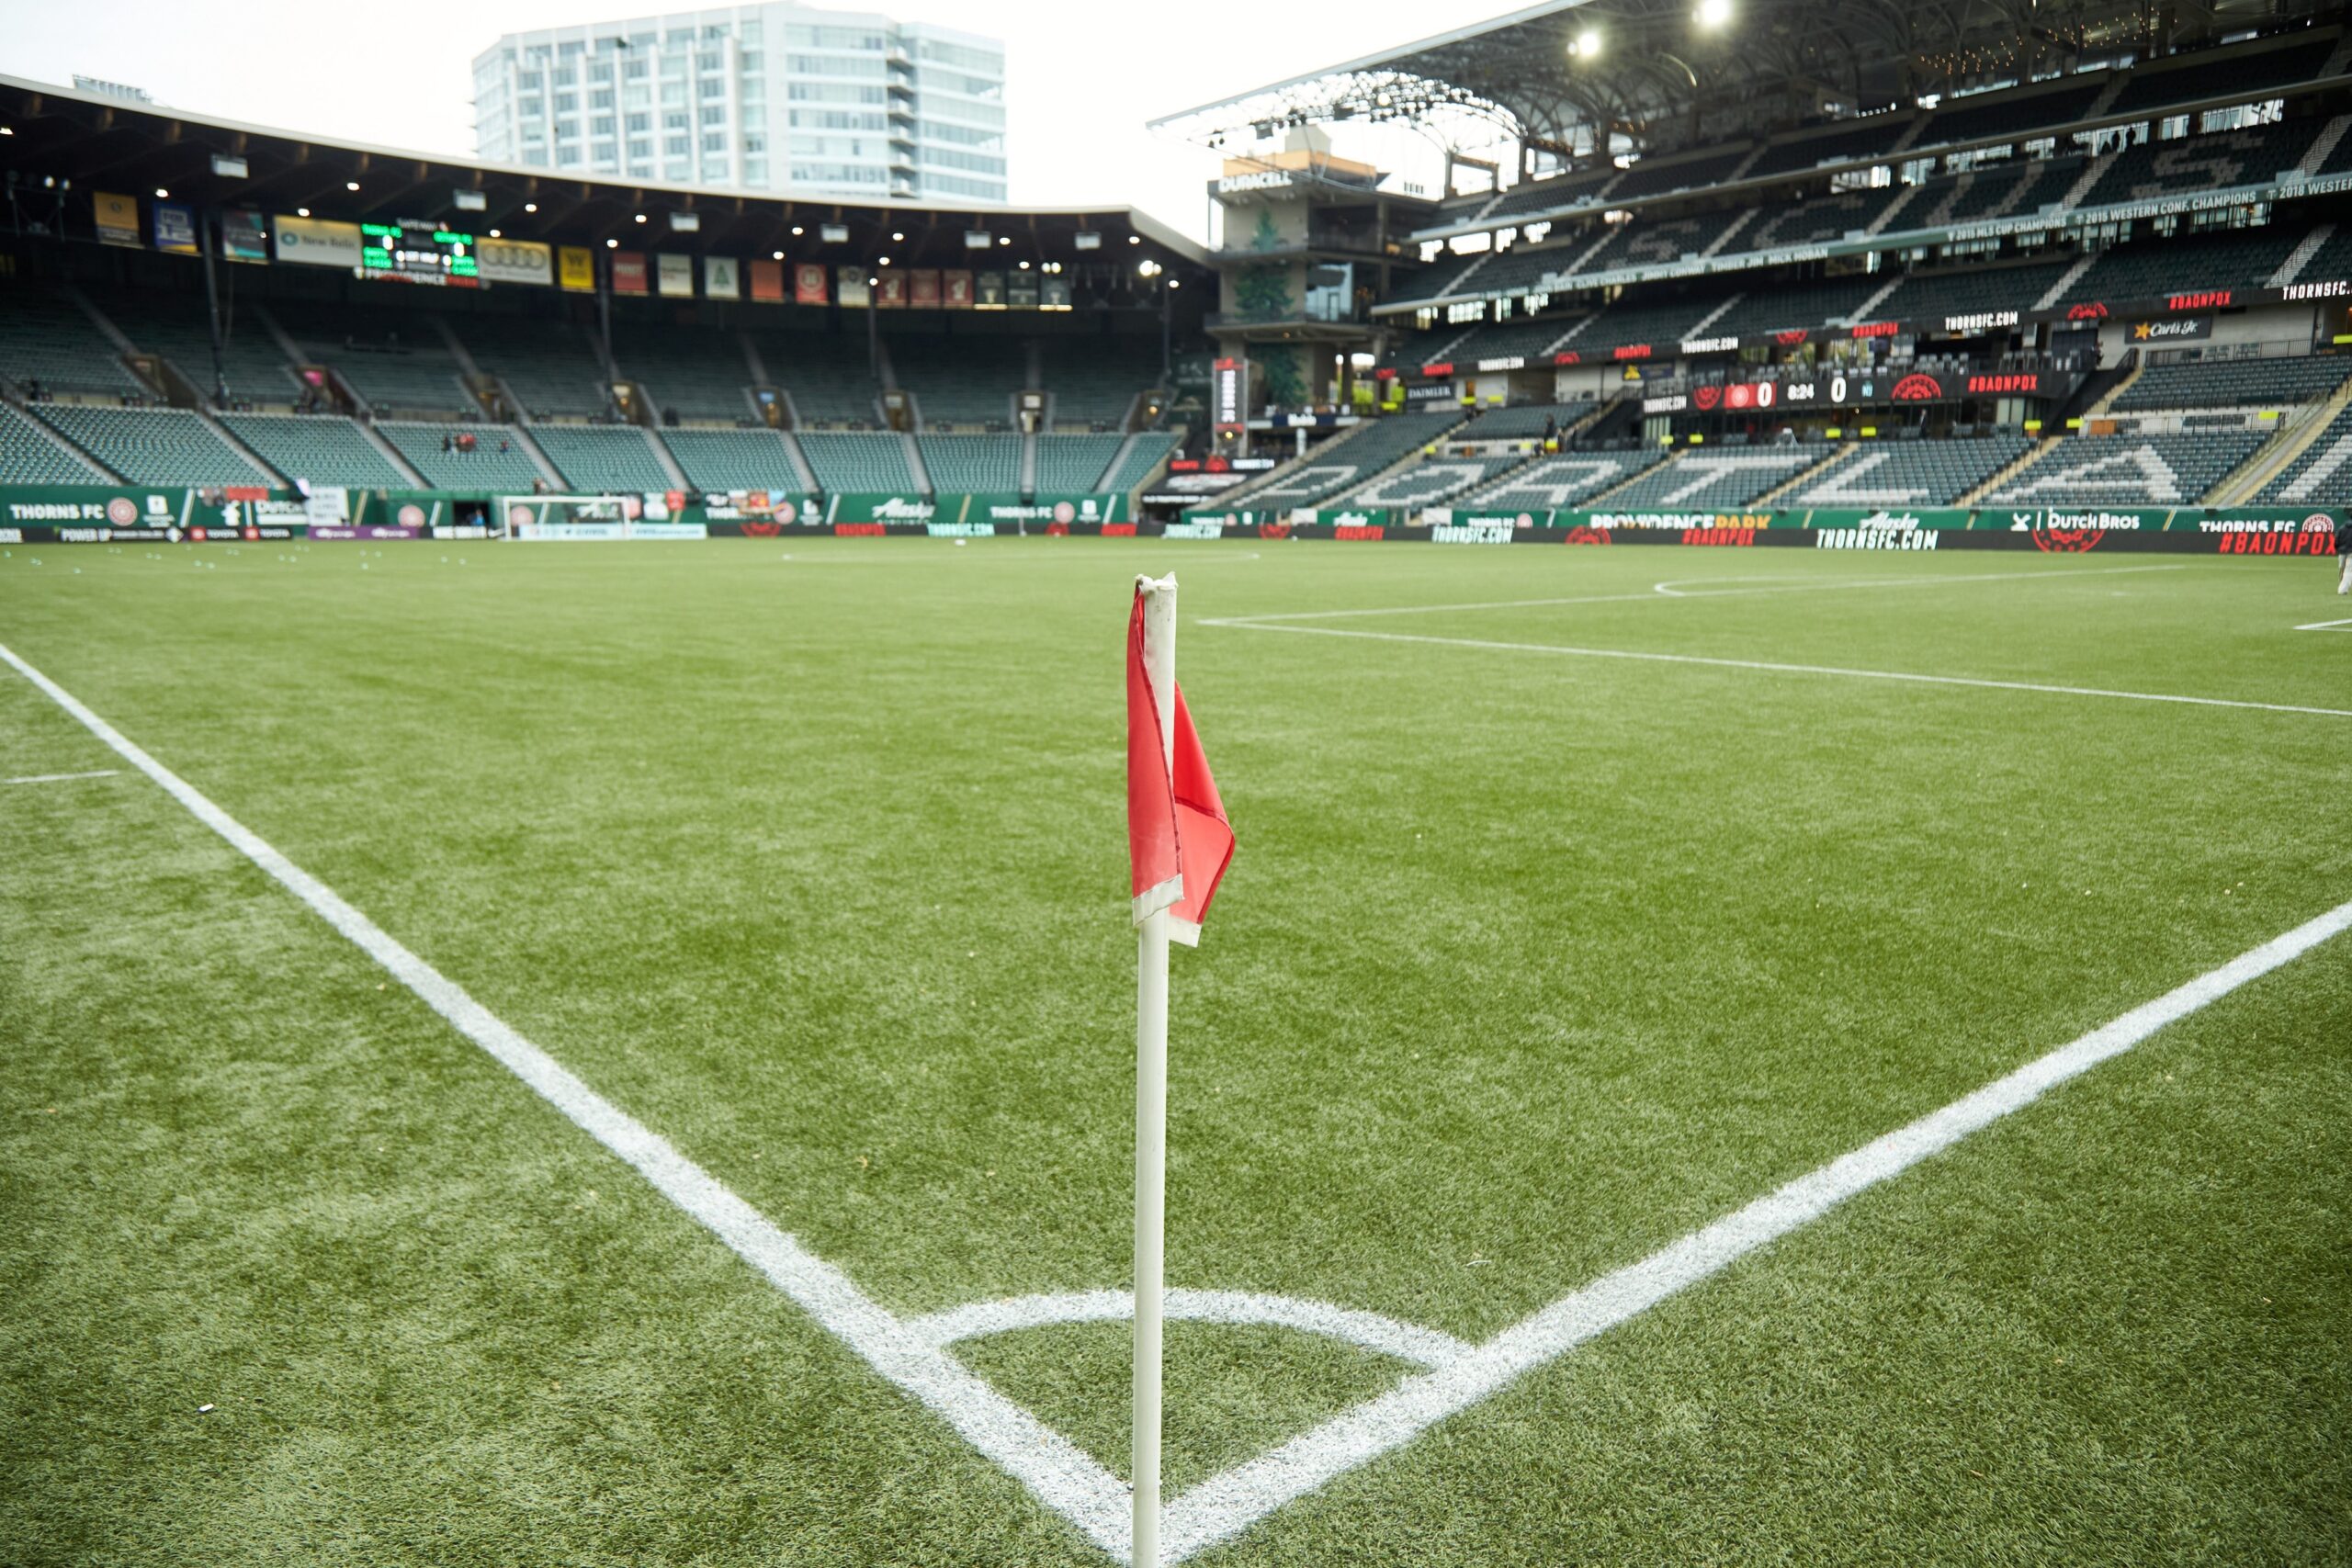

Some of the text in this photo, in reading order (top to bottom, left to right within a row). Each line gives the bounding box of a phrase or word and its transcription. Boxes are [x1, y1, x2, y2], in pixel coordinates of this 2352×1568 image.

[2279, 186, 2305, 199] 2018
[2109, 203, 2159, 221] WESTERN
[2160, 199, 2190, 215] CONF.
[2192, 191, 2256, 210] CHAMPIONS
[1996, 223, 2013, 235] CUP
[2015, 218, 2067, 233] CHAMPIONS
[2282, 280, 2352, 301] THORNSFC.
[1945, 310, 2018, 331] THORNSFC.COM
[1408, 385, 1451, 399] DAIMLER
[1757, 381, 1772, 408] 0
[1831, 377, 1847, 403] 0
[10, 503, 105, 520] THORNS FC
[1860, 511, 1920, 530] Alaska
[1590, 513, 1771, 530] PROVIDENCE PARK
[2199, 520, 2297, 533] THORNS FC
[1431, 526, 1513, 544] THORNSFC.COM
[1815, 528, 1939, 550] THORNSFC.COM
